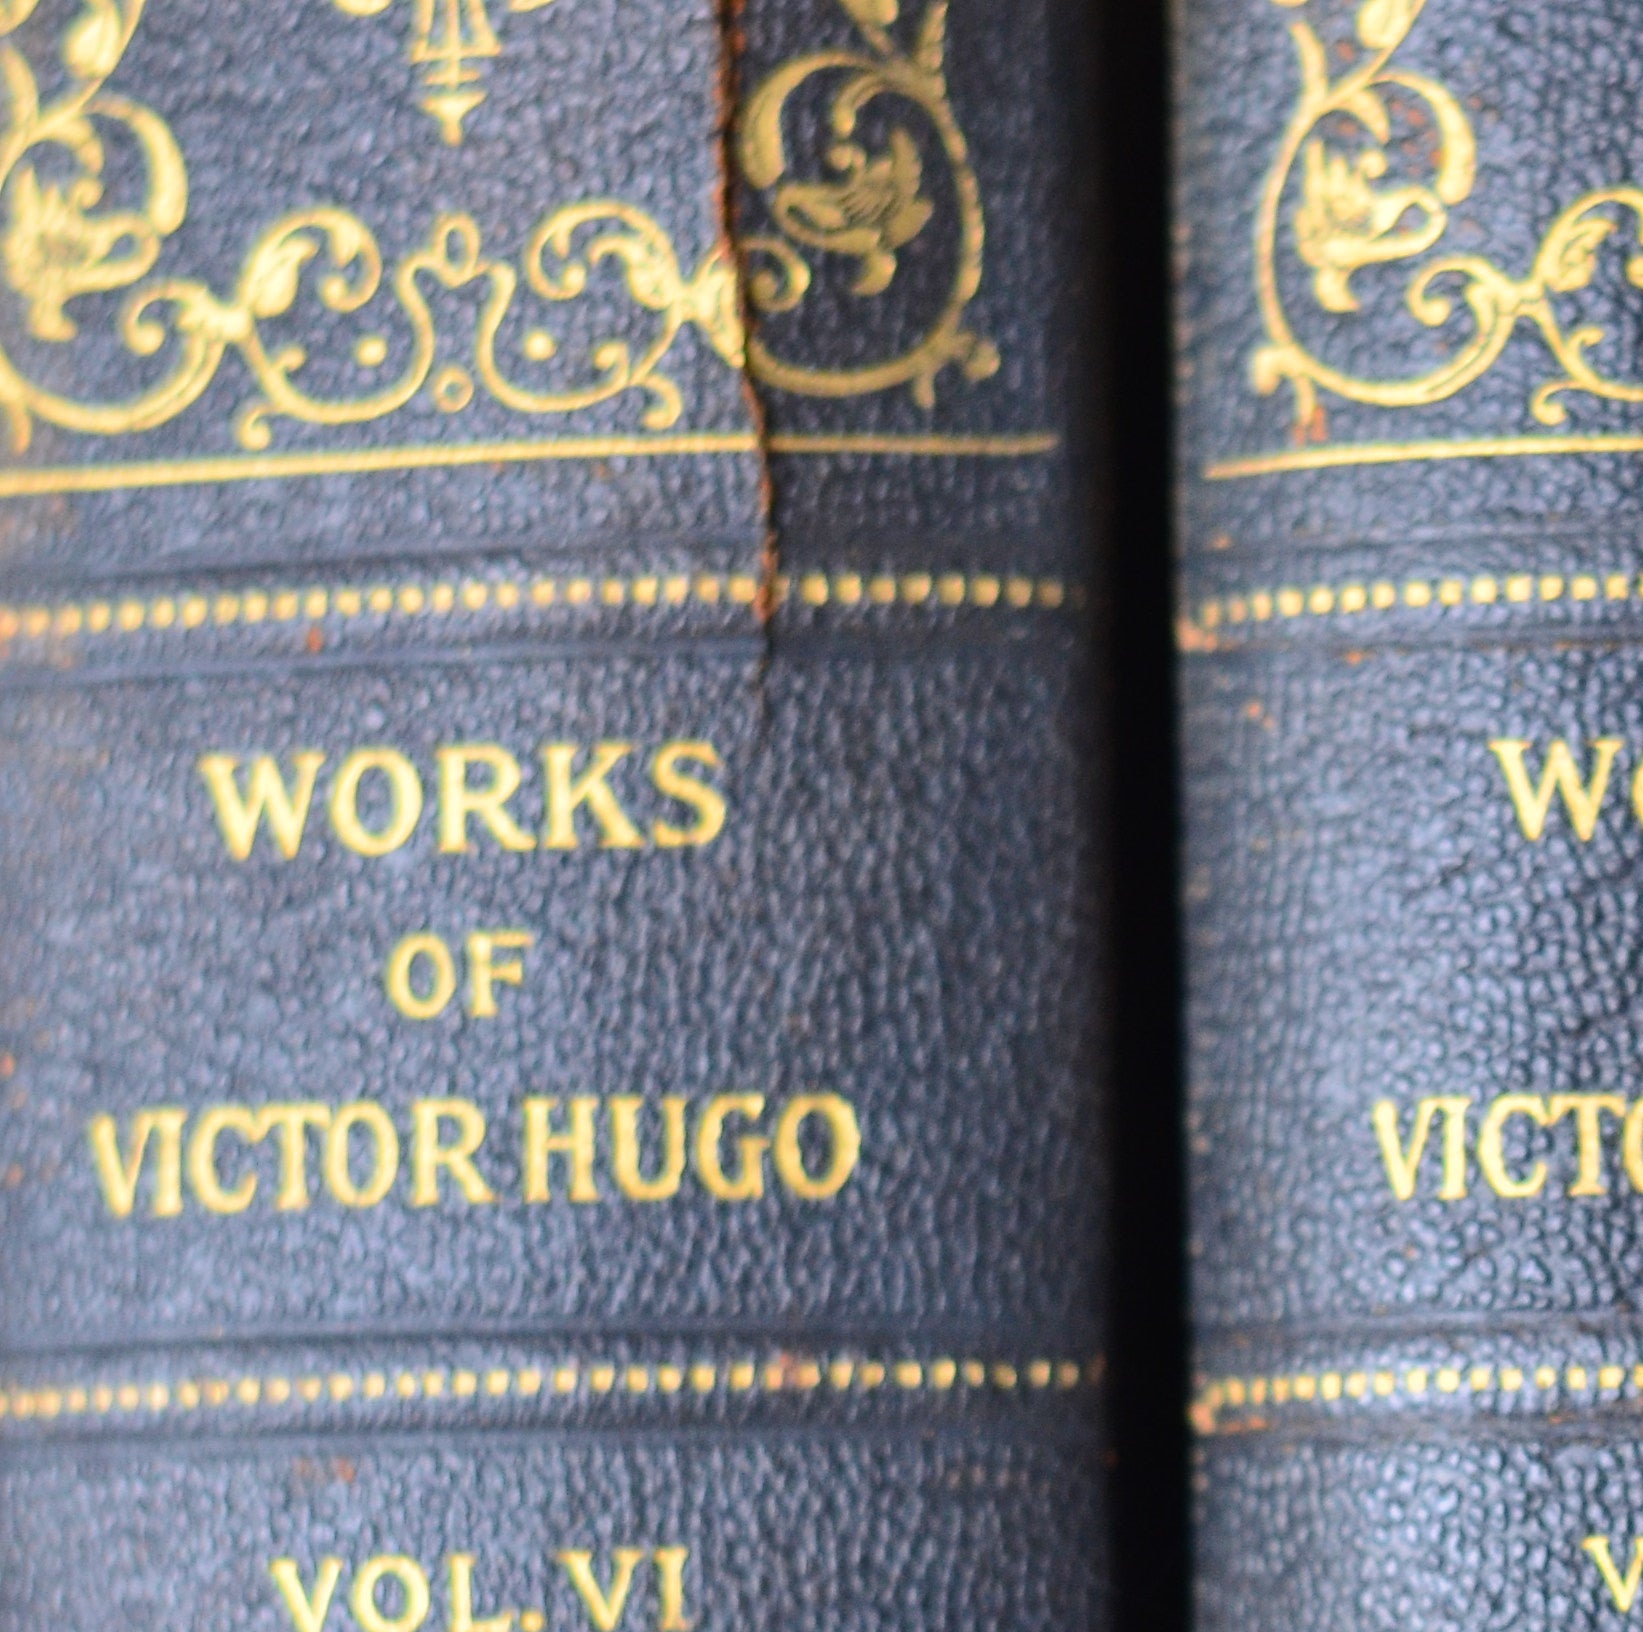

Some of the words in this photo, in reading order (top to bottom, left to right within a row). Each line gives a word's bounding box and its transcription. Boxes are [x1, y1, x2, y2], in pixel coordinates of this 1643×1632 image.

[201, 742, 727, 860] WORKS
[386, 932, 534, 1018] OF
[90, 1097, 493, 1216] VICTOR
[523, 1092, 861, 1203] HUGO
